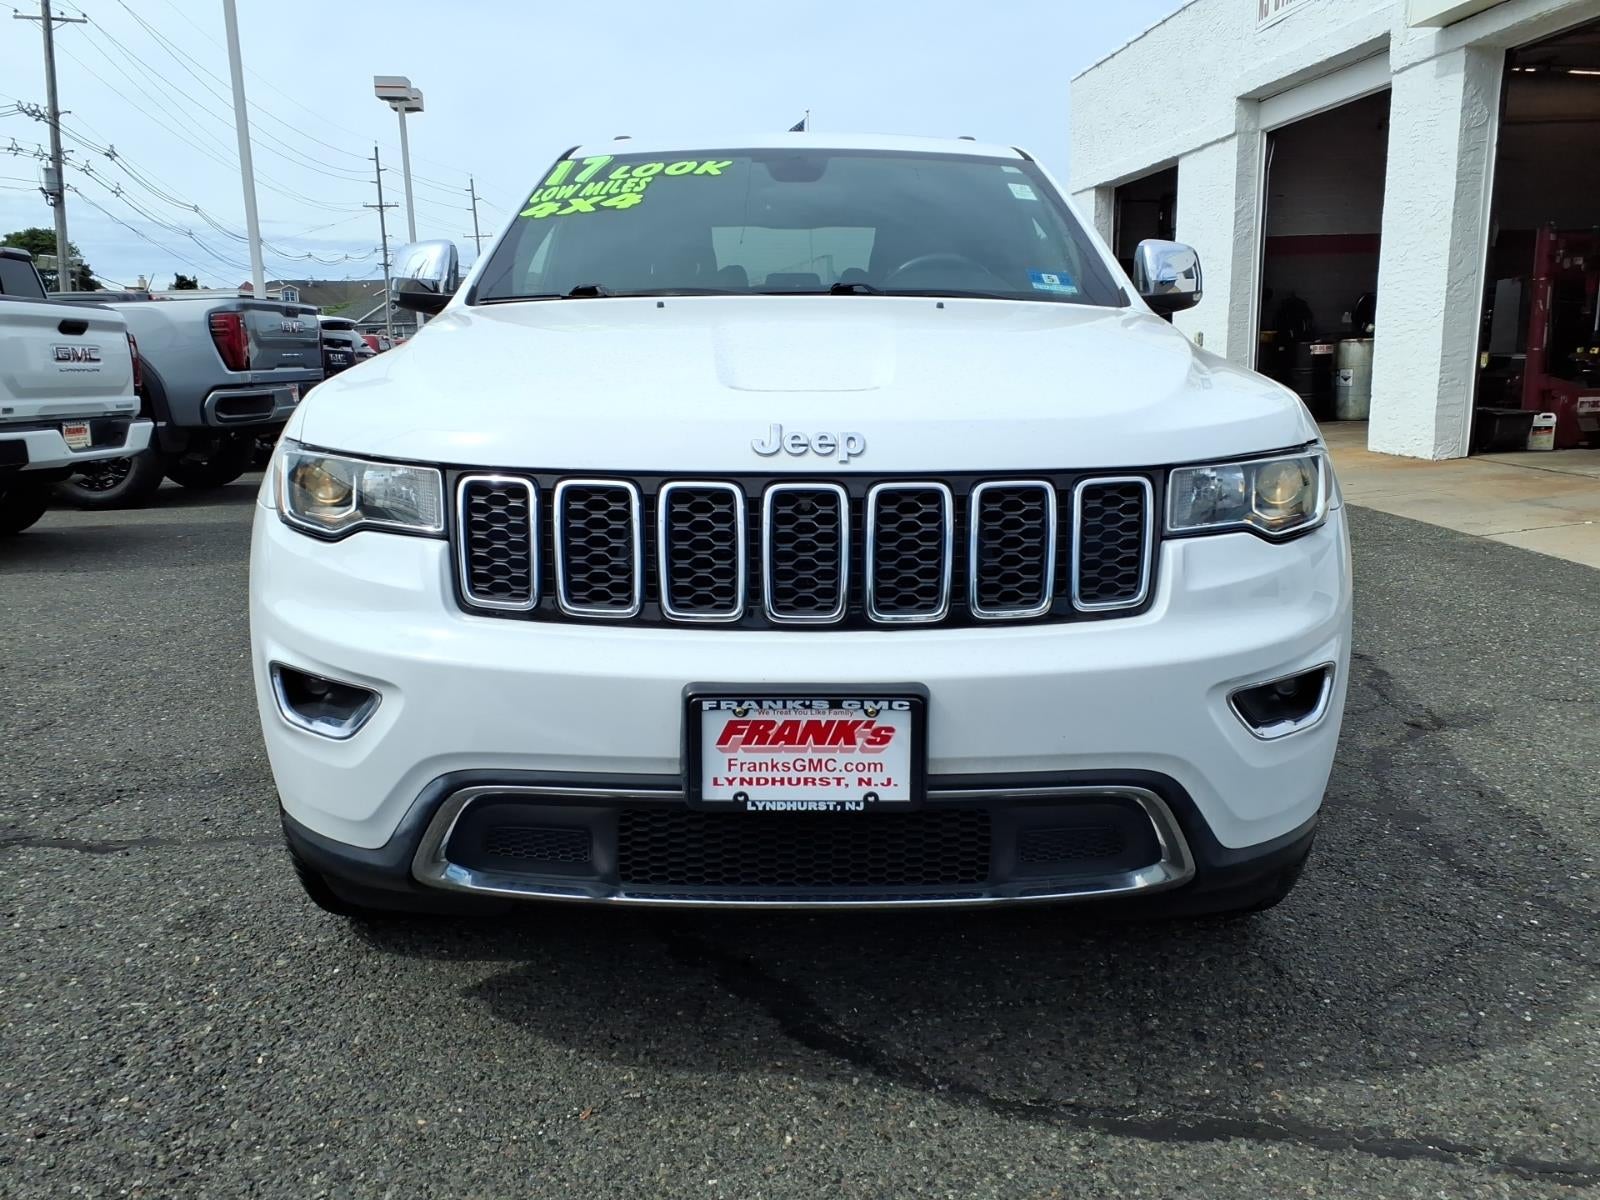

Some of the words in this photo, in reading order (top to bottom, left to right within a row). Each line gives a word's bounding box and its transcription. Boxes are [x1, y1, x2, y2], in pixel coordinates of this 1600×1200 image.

[545, 155, 614, 186] 17
[608, 160, 733, 180] LOOK
[529, 184, 582, 204] LOW
[579, 176, 653, 198] MILES
[54, 347, 101, 362] GMC
[751, 423, 866, 464] Jeep
[702, 700, 829, 711] FRANK'S
[841, 700, 911, 711] GMC
[772, 709, 791, 717] Treat
[793, 709, 809, 717] You
[810, 709, 826, 717] Like
[727, 758, 884, 773] FranksGMC.com
[712, 777, 850, 788] LYNDHURST,
[857, 777, 899, 787] N.J.
[746, 801, 842, 811] LYNDHURST,
[844, 801, 865, 811] NJ
